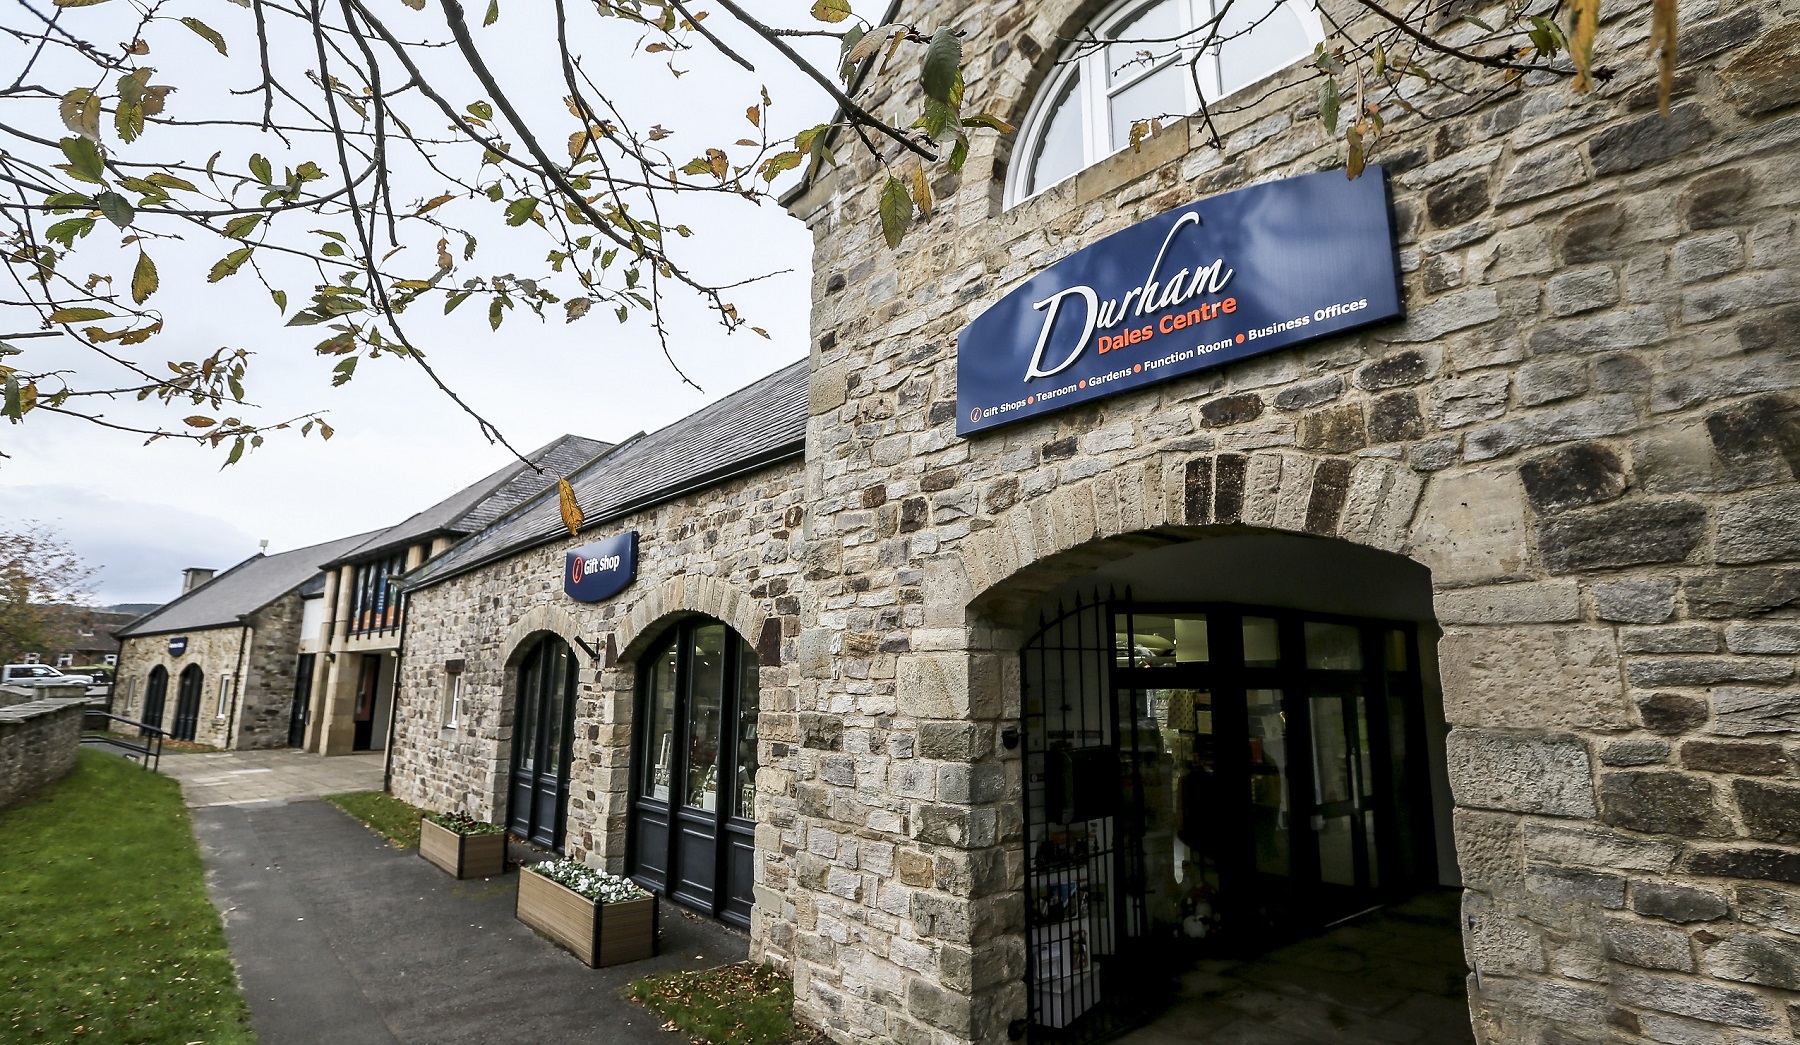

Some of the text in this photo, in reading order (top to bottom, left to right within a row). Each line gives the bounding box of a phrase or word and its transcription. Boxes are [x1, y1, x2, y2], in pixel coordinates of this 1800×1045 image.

[1023, 211, 1233, 383] Durham
[1098, 296, 1238, 355] Dales Centre
[983, 408, 998, 418] Gift
[1000, 399, 1027, 413] Shops
[1036, 383, 1077, 402] Tearoom
[1088, 367, 1132, 387] Gardens
[1144, 349, 1194, 372] Function
[1197, 337, 1233, 356] Room
[1248, 315, 1310, 341] Business
[1313, 298, 1368, 322] Offices
[584, 558, 599, 575] Gift
[600, 555, 620, 571] shop
